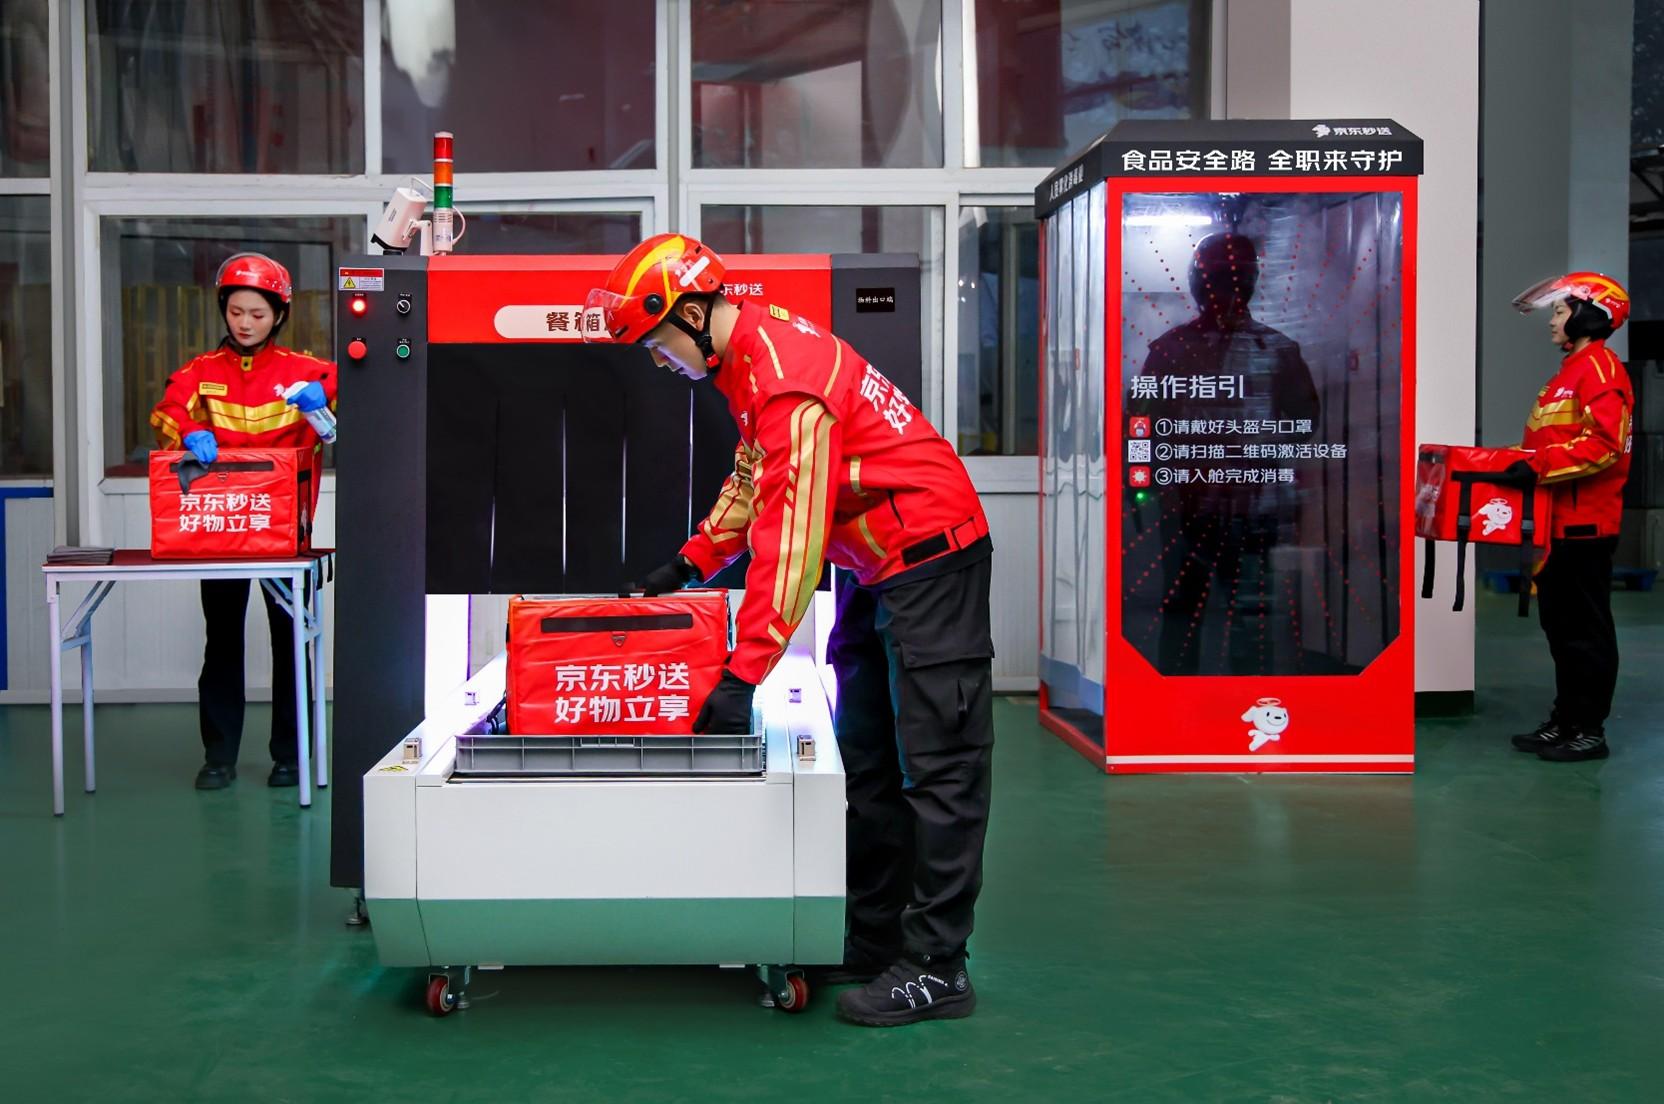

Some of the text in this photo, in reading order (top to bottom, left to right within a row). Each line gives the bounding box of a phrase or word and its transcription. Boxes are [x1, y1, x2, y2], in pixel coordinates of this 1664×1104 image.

[1332, 127, 1392, 136] 京东秒送
[1121, 149, 1403, 171] 食品安全路 全职来守护
[546, 311, 608, 332] 餐箱
[1130, 375, 1245, 399] 操作指引
[1154, 418, 1313, 437] ①请戴好头盔与口罩
[1154, 443, 1348, 461] ②请扫描二维码激活设备
[1154, 467, 1295, 486] ③请入舱完成消毒
[179, 493, 272, 512] 京东秒送
[179, 514, 272, 533] 好物立享
[555, 662, 690, 692] 京东秒送
[554, 694, 690, 724] 好物立享
